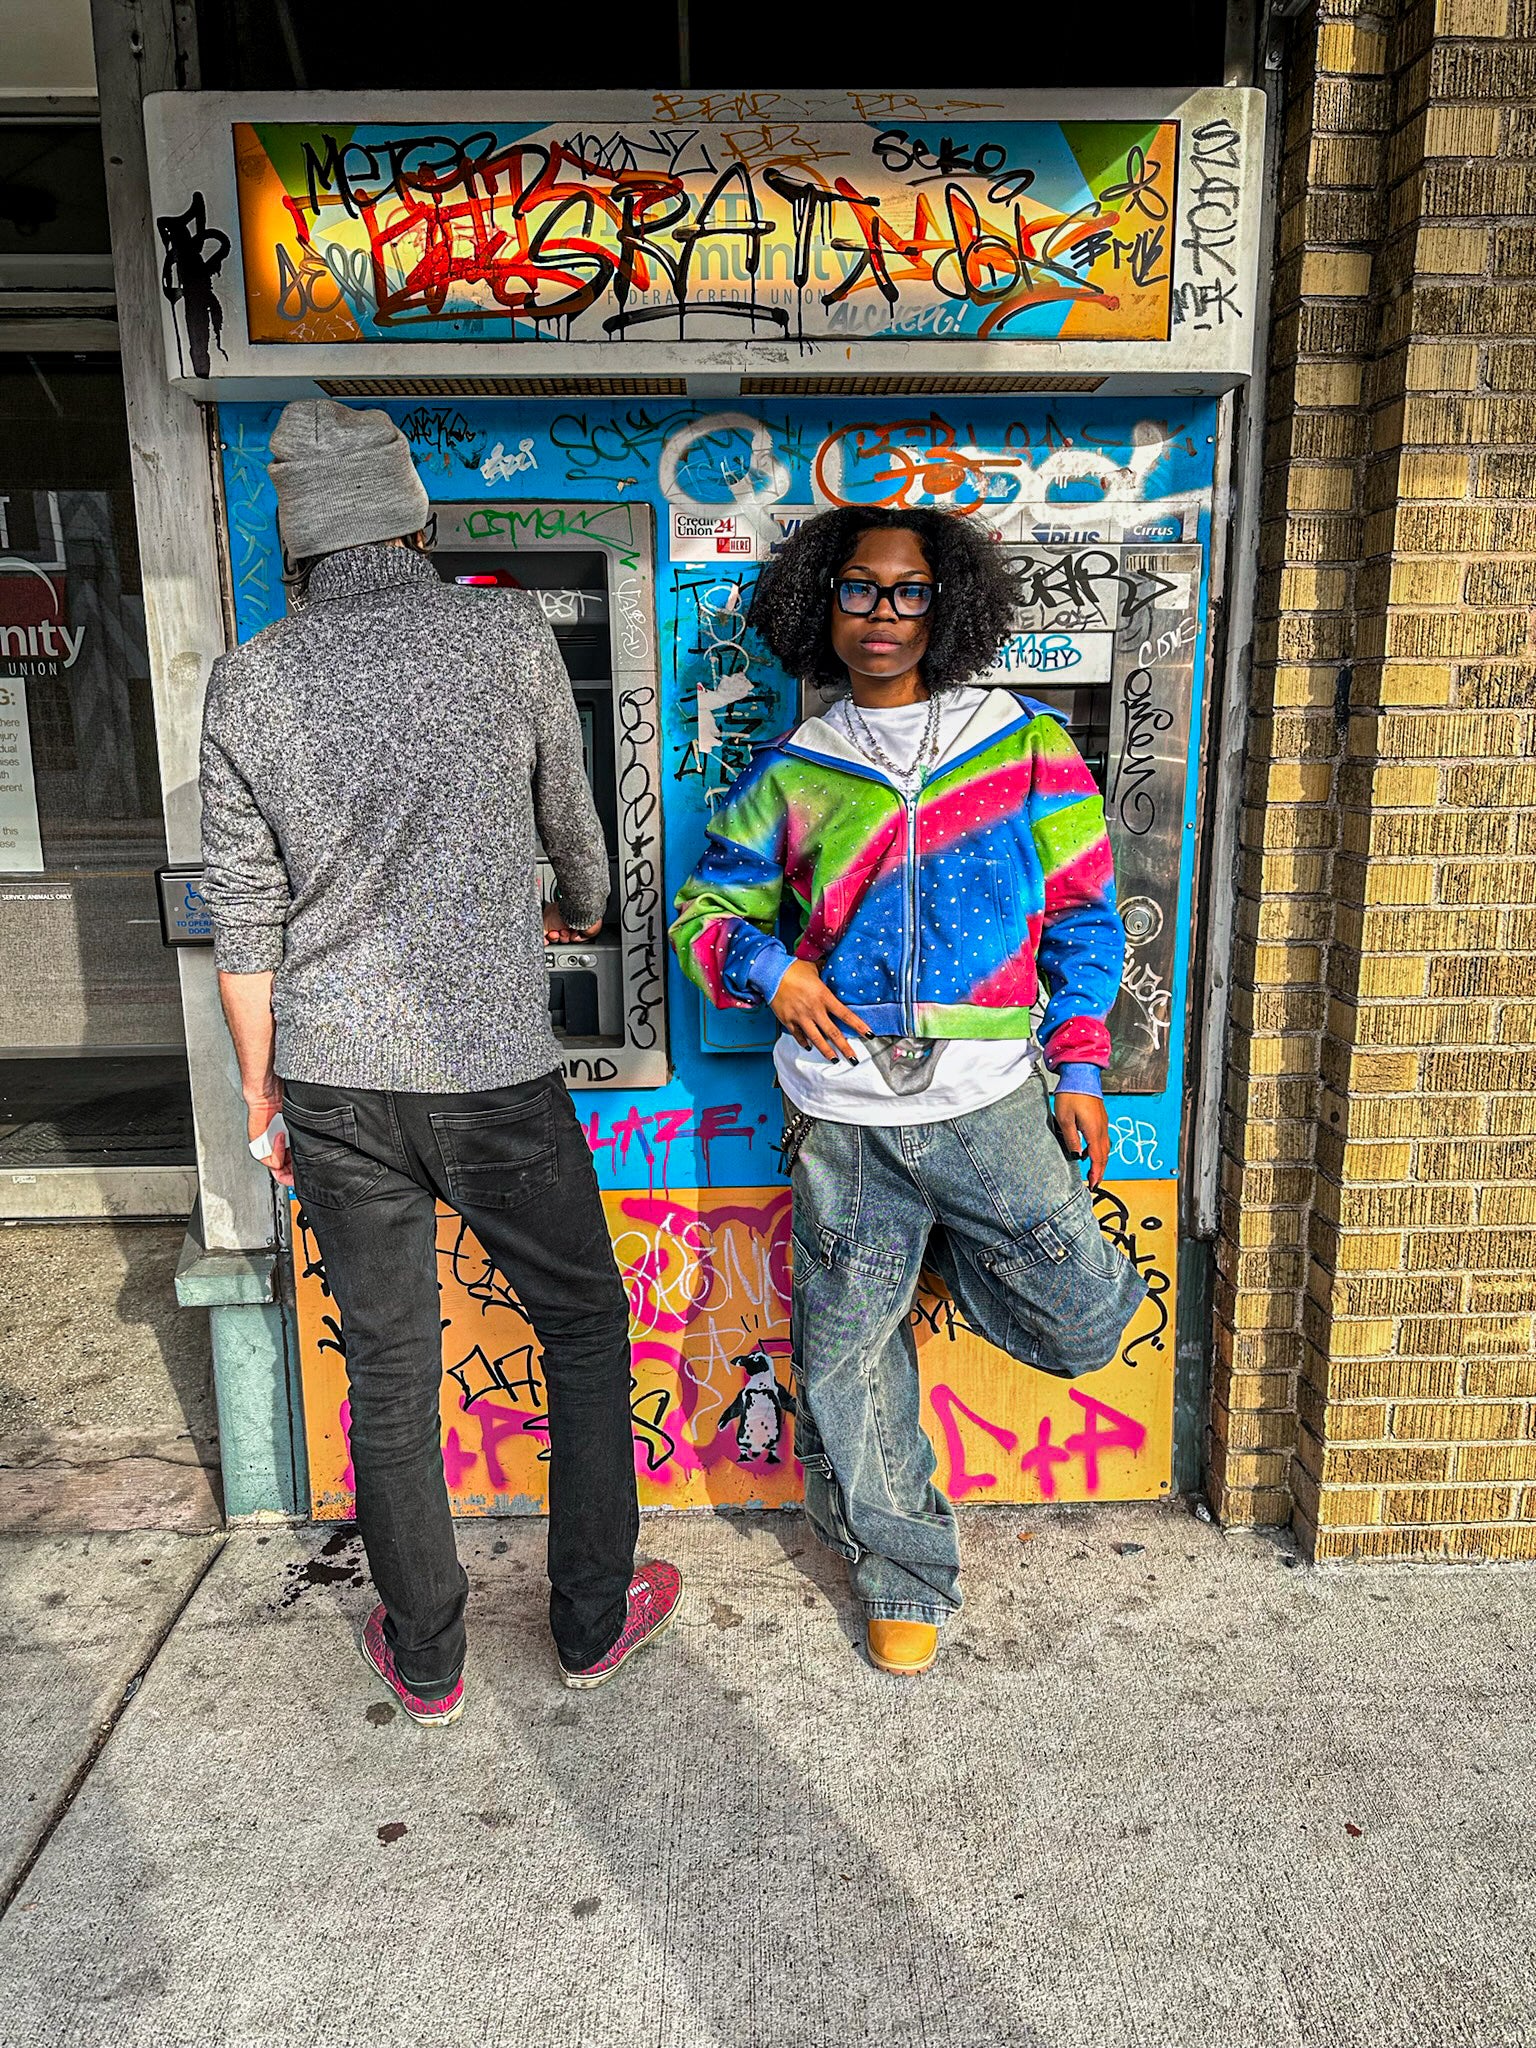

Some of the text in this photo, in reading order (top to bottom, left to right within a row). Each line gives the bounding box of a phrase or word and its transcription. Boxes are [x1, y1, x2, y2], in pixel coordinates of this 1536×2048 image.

[607, 288, 679, 305] FDERA
[771, 288, 828, 305] UNON
[677, 525, 713, 536] Union
[714, 517, 734, 533] 24
[1133, 525, 1174, 536] Cirrus
[730, 540, 750, 551] HERE
[8, 662, 58, 676] UNION
[176, 920, 187, 928] TO
